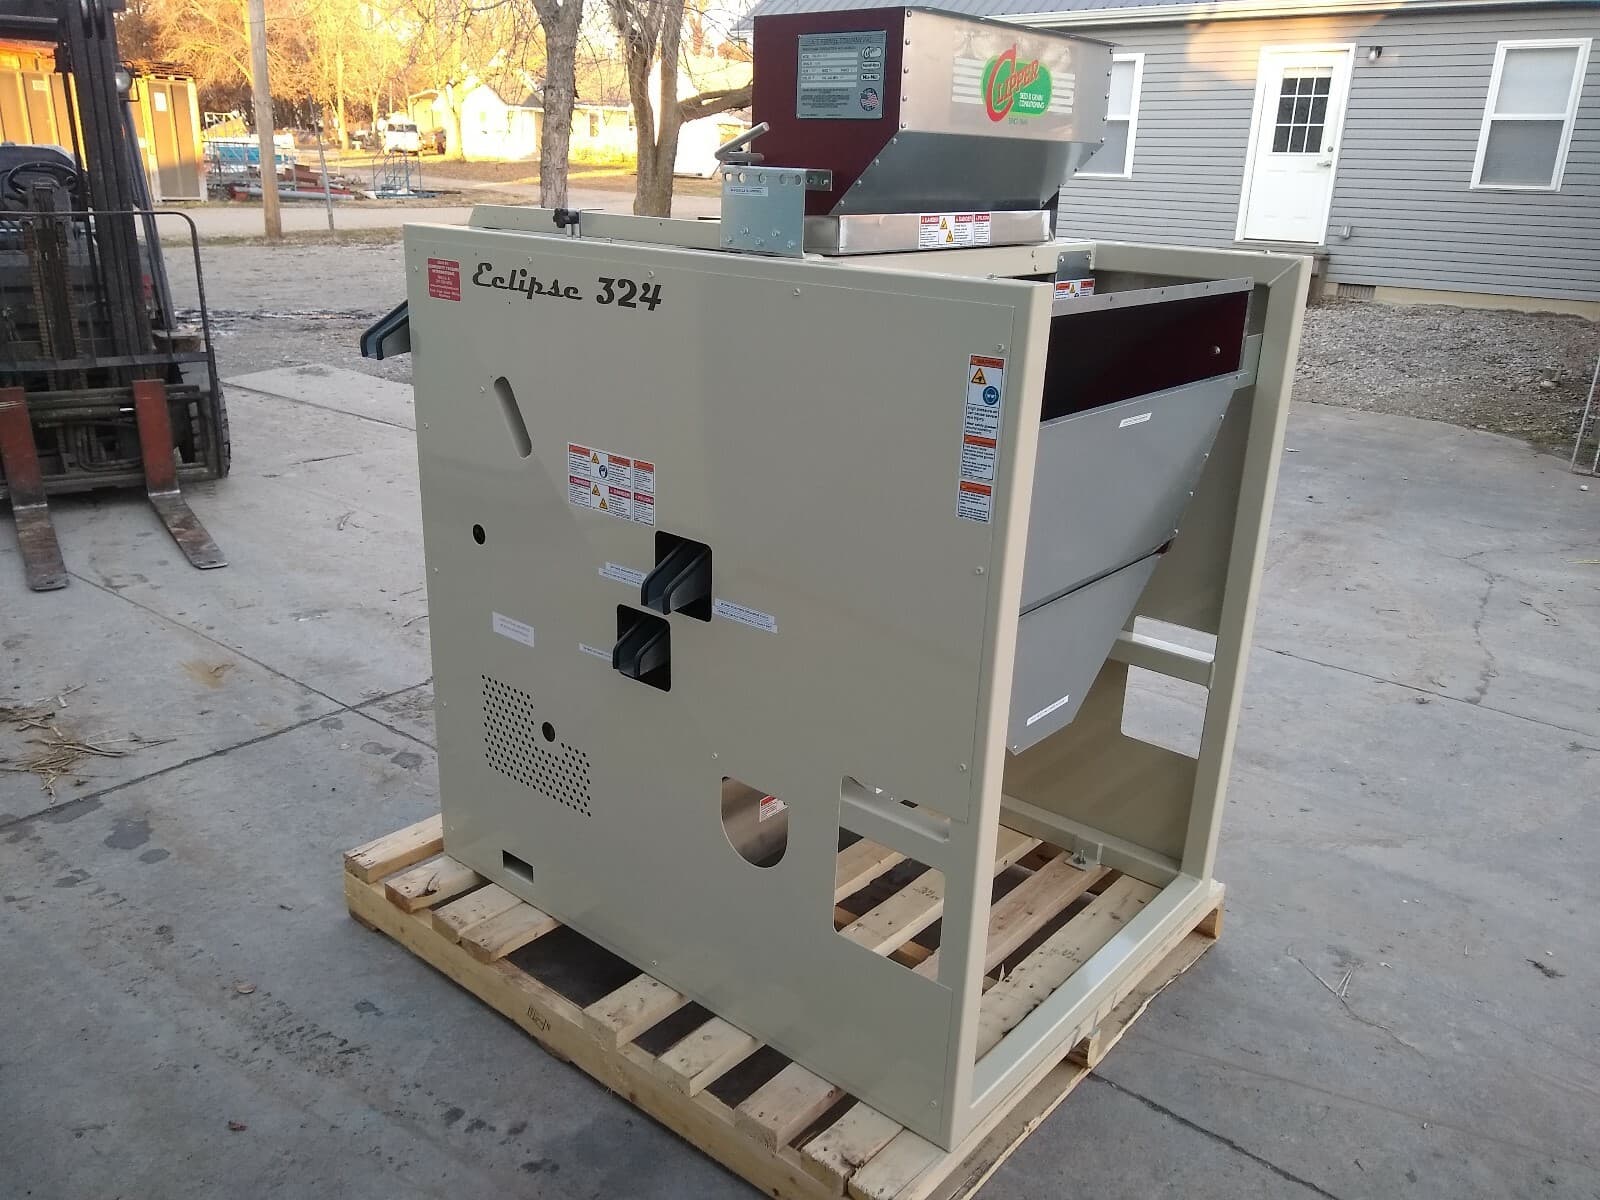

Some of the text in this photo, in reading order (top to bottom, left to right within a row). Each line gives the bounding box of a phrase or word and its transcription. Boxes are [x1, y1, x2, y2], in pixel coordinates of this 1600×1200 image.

[986, 43, 1039, 122] CLIPPER
[472, 263, 583, 299] Eclipse
[596, 277, 662, 311] 324
